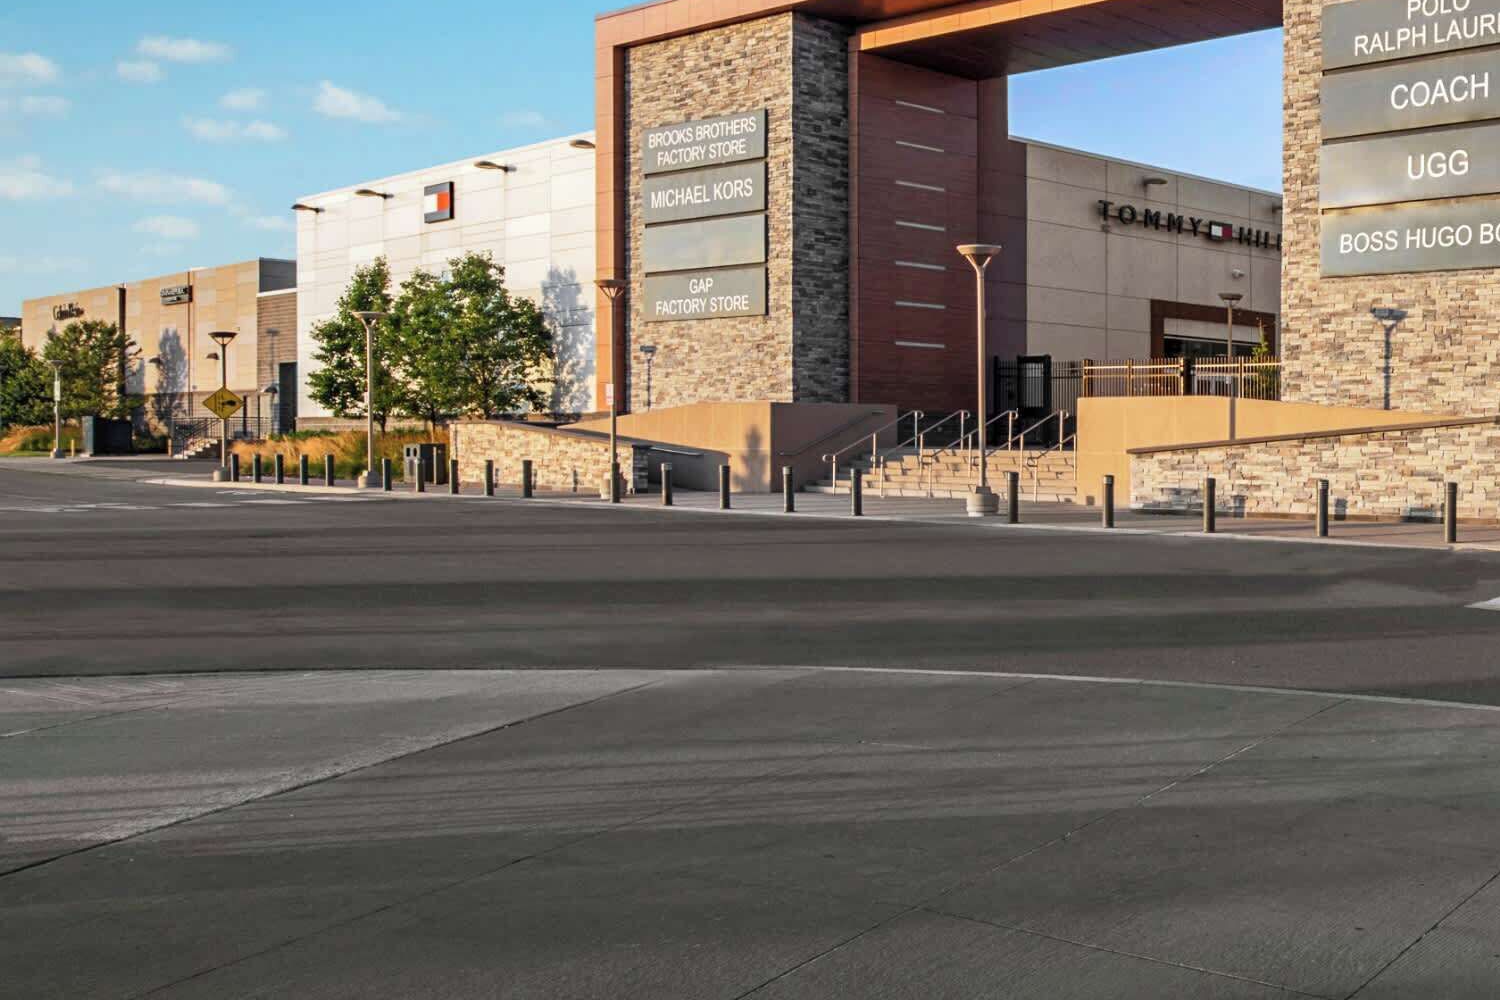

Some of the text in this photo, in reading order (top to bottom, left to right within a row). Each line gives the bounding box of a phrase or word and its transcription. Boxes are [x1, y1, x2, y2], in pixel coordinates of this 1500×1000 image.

[1354, 23, 1427, 57] RALPH
[1390, 71, 1490, 110] COACH
[648, 116, 757, 149] BROOKS BROTHERS
[657, 138, 747, 167] FACTORY STORE
[1407, 149, 1470, 180] UGG
[651, 177, 753, 209] MICHAEL KORS
[1098, 199, 1203, 238] TOMMY
[1339, 228, 1399, 254] BOSS
[1405, 224, 1473, 249] HUGO
[689, 277, 714, 294] GAP
[656, 294, 750, 316] FACTORY STORE
